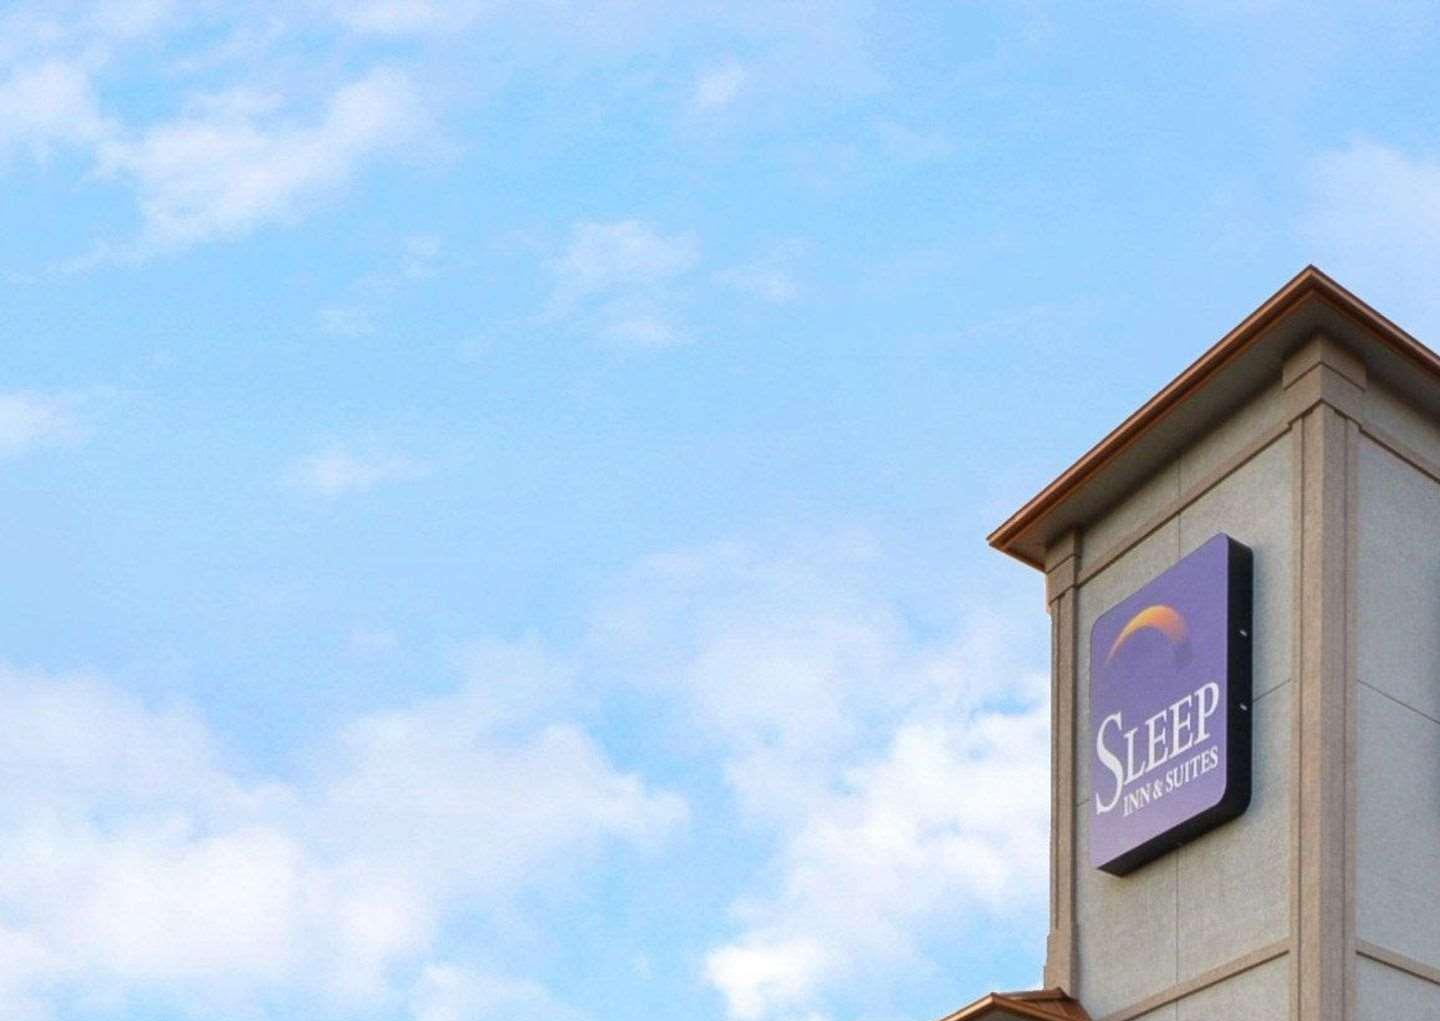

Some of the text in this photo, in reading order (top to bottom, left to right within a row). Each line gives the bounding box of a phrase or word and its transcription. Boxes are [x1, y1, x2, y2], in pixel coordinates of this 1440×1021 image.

[1096, 681, 1219, 815] SLEEP
[1123, 745, 1219, 817] INN & SUITES
